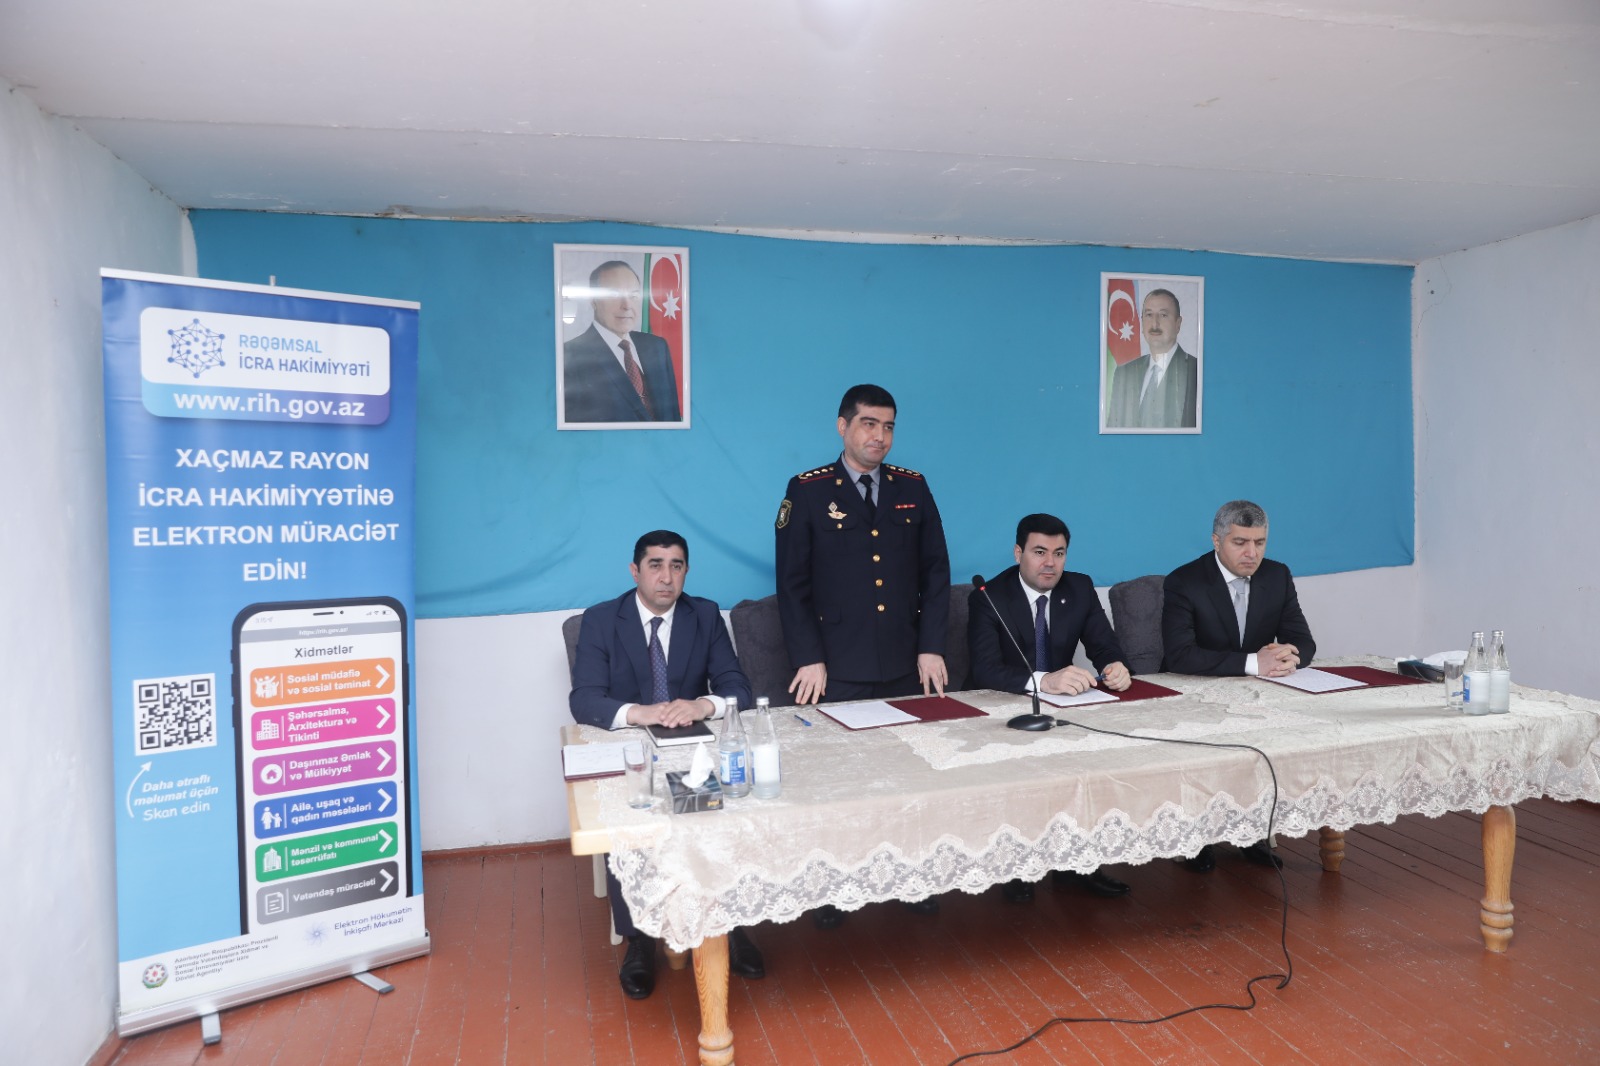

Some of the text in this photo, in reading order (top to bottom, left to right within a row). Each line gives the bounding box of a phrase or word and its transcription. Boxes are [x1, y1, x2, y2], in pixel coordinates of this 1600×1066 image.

[239, 334, 322, 354] RƏQƏMSAL
[239, 351, 371, 376] İCRA HAKİMİYYƏTİ
[173, 392, 365, 419] www.rih.gov.az
[176, 448, 369, 472] XAÇMAZ RAYON
[138, 483, 394, 507] İCRA HAKİMİYYƏTİNƏ
[133, 520, 399, 547] ELEKTRON MÜRACİƏT
[243, 558, 307, 581] EDİN!
[294, 644, 354, 659] Xidmətlər
[287, 669, 360, 684] Sosial müdafiə
[288, 687, 300, 695] və
[302, 683, 332, 694] sosial
[288, 717, 357, 732] Arxitektura və
[288, 731, 320, 743] Tikinti
[289, 750, 371, 769] Daşınmaz Əmlak
[304, 765, 352, 778] Mülkiyyət
[142, 780, 174, 792] Daha
[189, 785, 219, 798] üçün
[143, 800, 210, 821] Skan edin
[291, 795, 354, 813] Ailə, uşaq və
[291, 813, 320, 825] qadın
[291, 843, 320, 857] Mənzil
[335, 834, 379, 848] kommunal
[293, 887, 335, 902] Vətəndaş
[334, 917, 369, 930] Elektron
